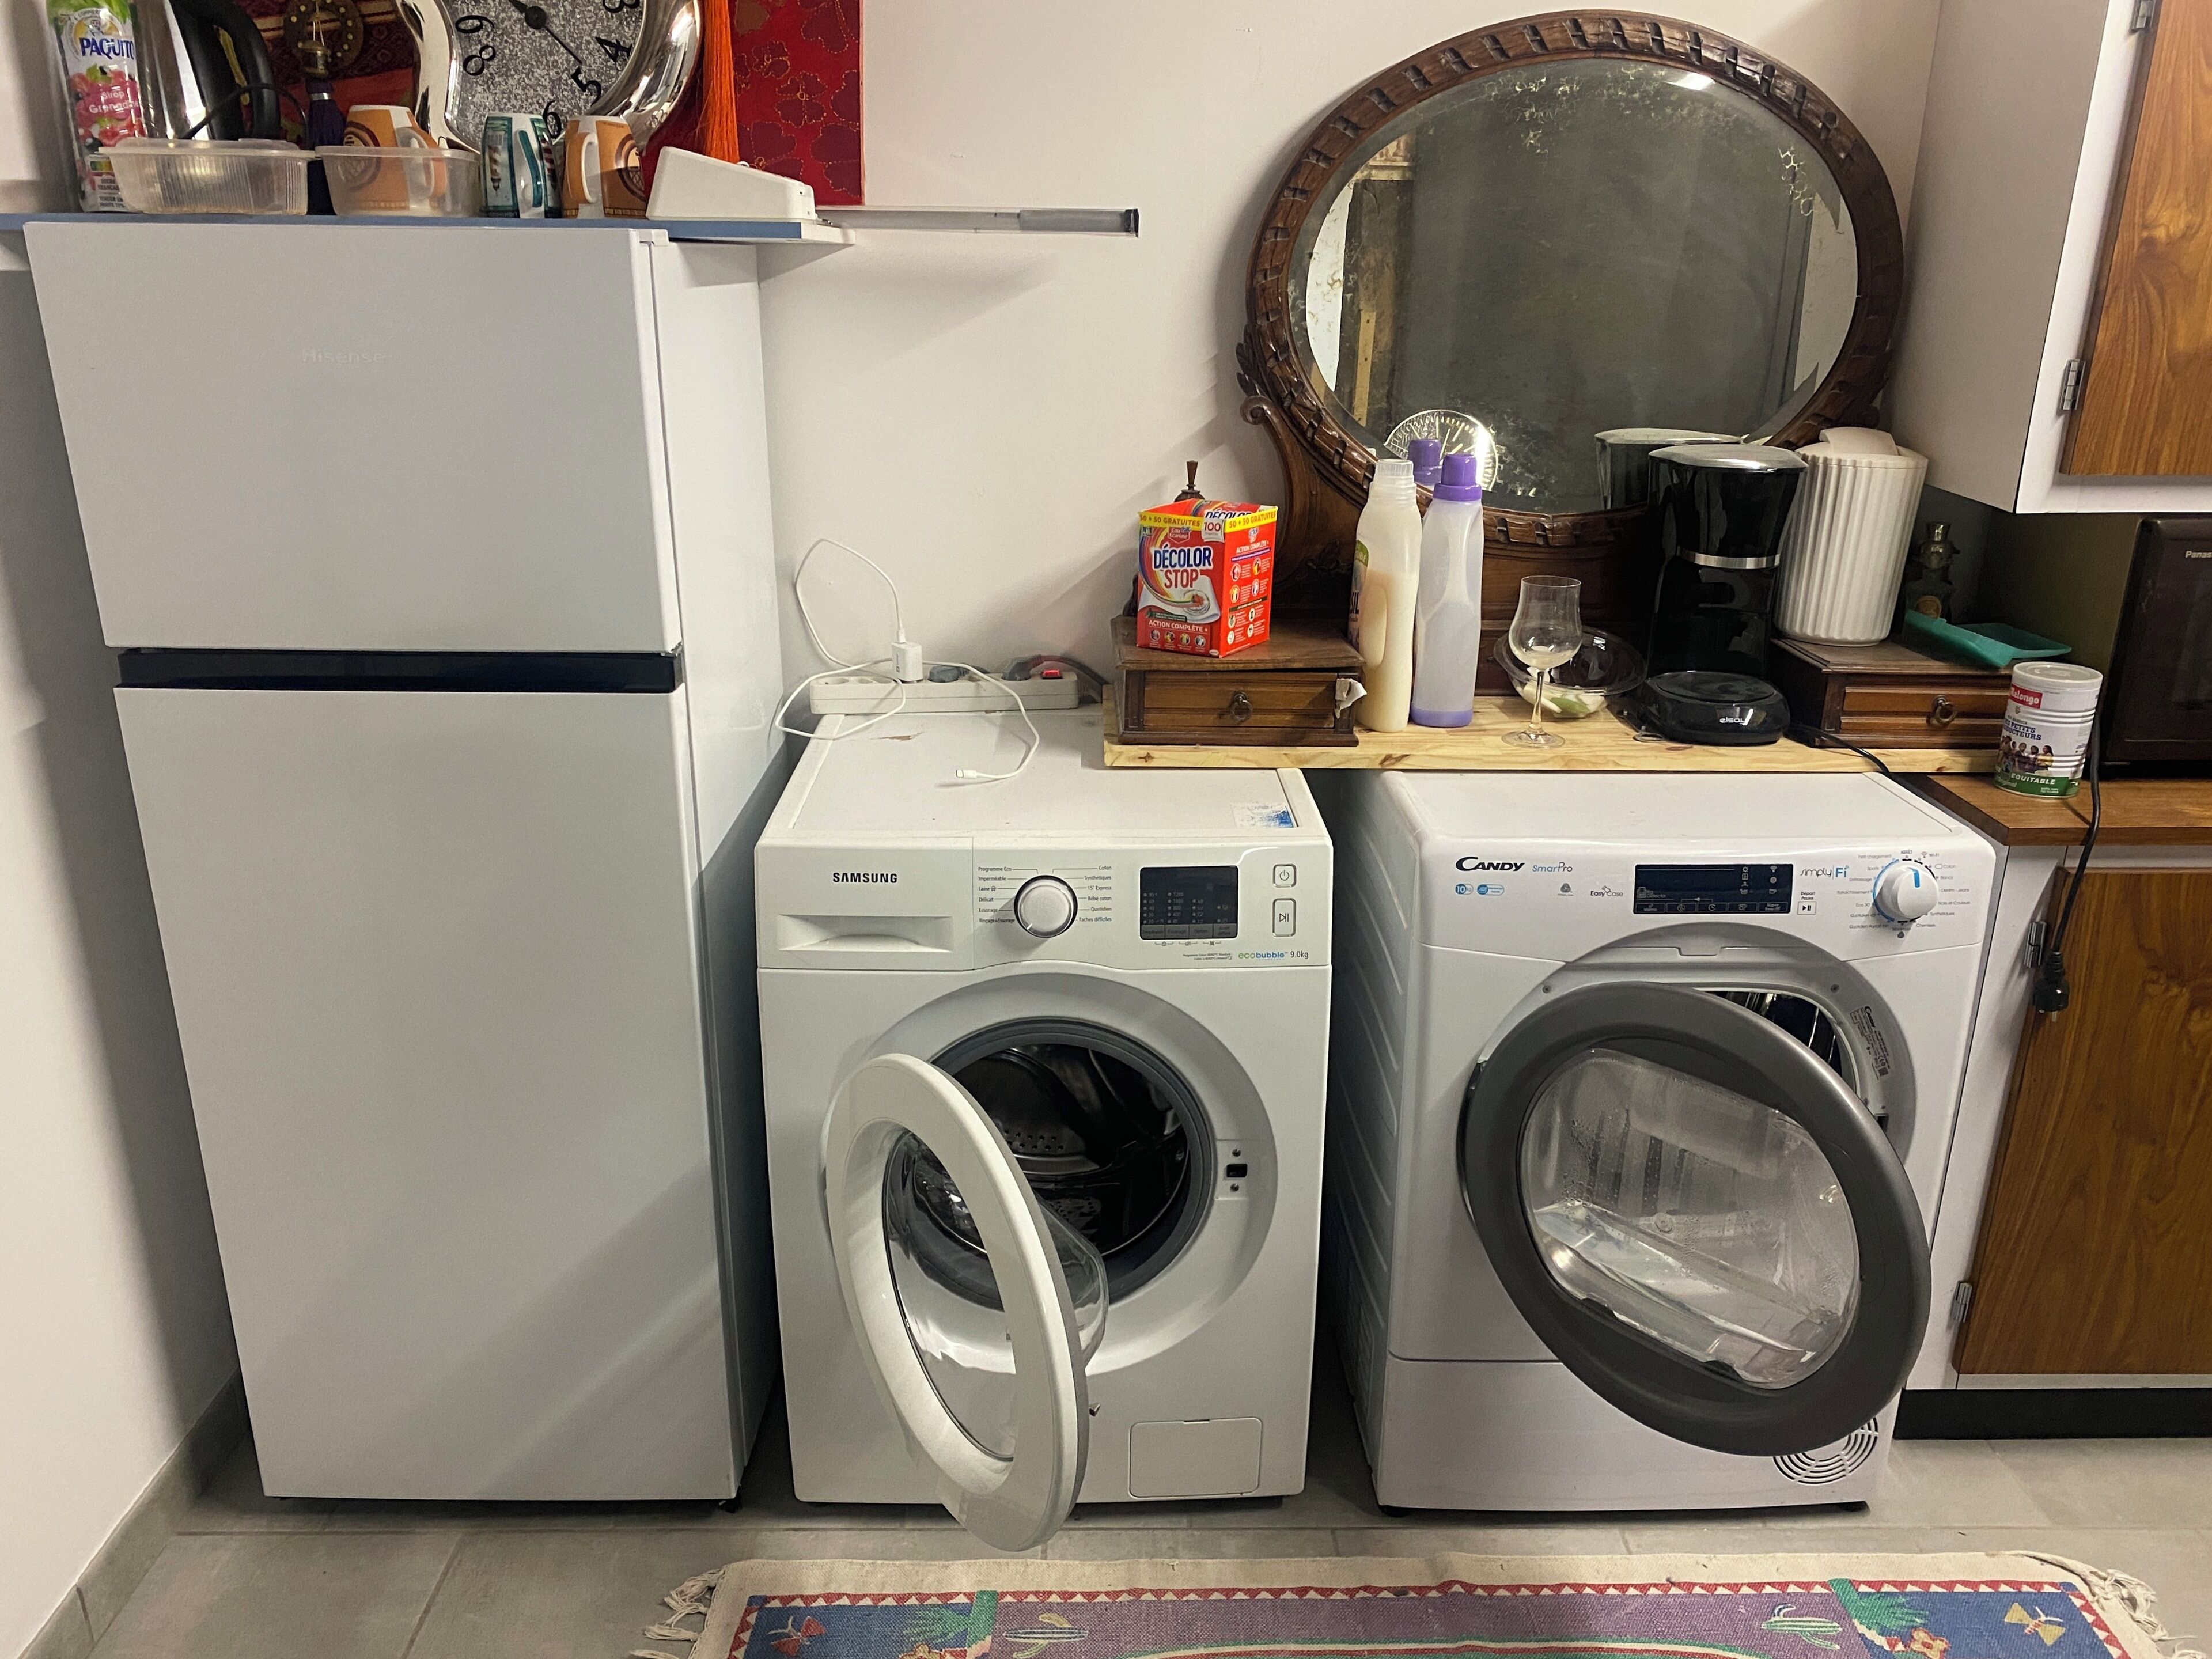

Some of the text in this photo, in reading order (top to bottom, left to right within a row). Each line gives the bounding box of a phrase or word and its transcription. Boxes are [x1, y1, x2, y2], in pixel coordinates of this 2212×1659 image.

[596, 37, 632, 62] 4
[463, 45, 496, 76] 8
[571, 66, 601, 106] 5
[543, 100, 561, 138] 6
[302, 349, 384, 363] Hisense
[1163, 518, 1200, 527] GRATUITES
[1204, 522, 1221, 531] 100
[1229, 520, 1237, 528] 50
[1243, 517, 1249, 525] 50
[1153, 544, 1211, 569] DÉCOLOR
[1164, 569, 1199, 589] STOP
[1149, 620, 1171, 628] ACTION
[1171, 623, 1203, 632] COMPLÈTE
[2011, 722, 2036, 733] PETITS
[2011, 773, 2056, 785] EQUITABLE
[1456, 857, 1525, 871] CANDY
[833, 872, 897, 883] SAMSUNG
[1456, 885, 1465, 893] 10
